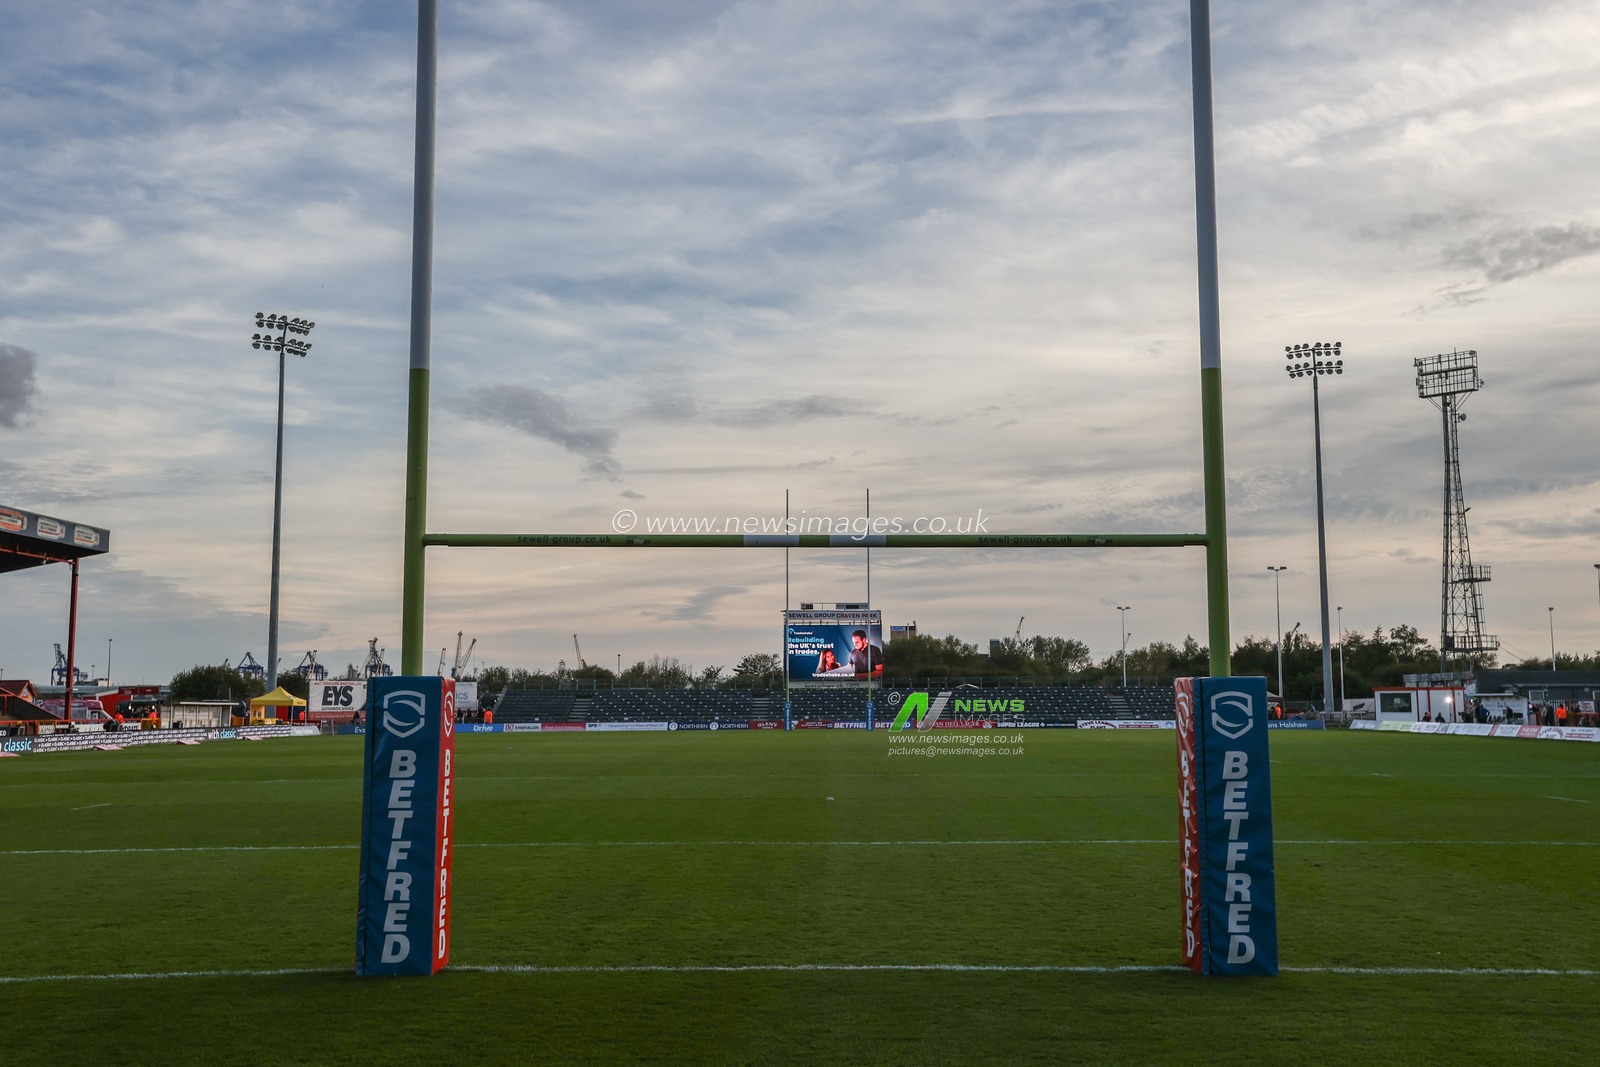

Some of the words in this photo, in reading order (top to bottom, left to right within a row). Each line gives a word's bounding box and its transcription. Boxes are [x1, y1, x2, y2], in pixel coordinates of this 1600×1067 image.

[4, 737, 32, 752] classic
[208, 731, 219, 740] with
[220, 728, 237, 739] classic
[321, 686, 353, 706] EYS
[381, 749, 417, 963] BETFRED
[438, 748, 451, 959] BETFRED
[1180, 750, 1194, 958] BETFRED
[1222, 750, 1255, 964] BETFRED
